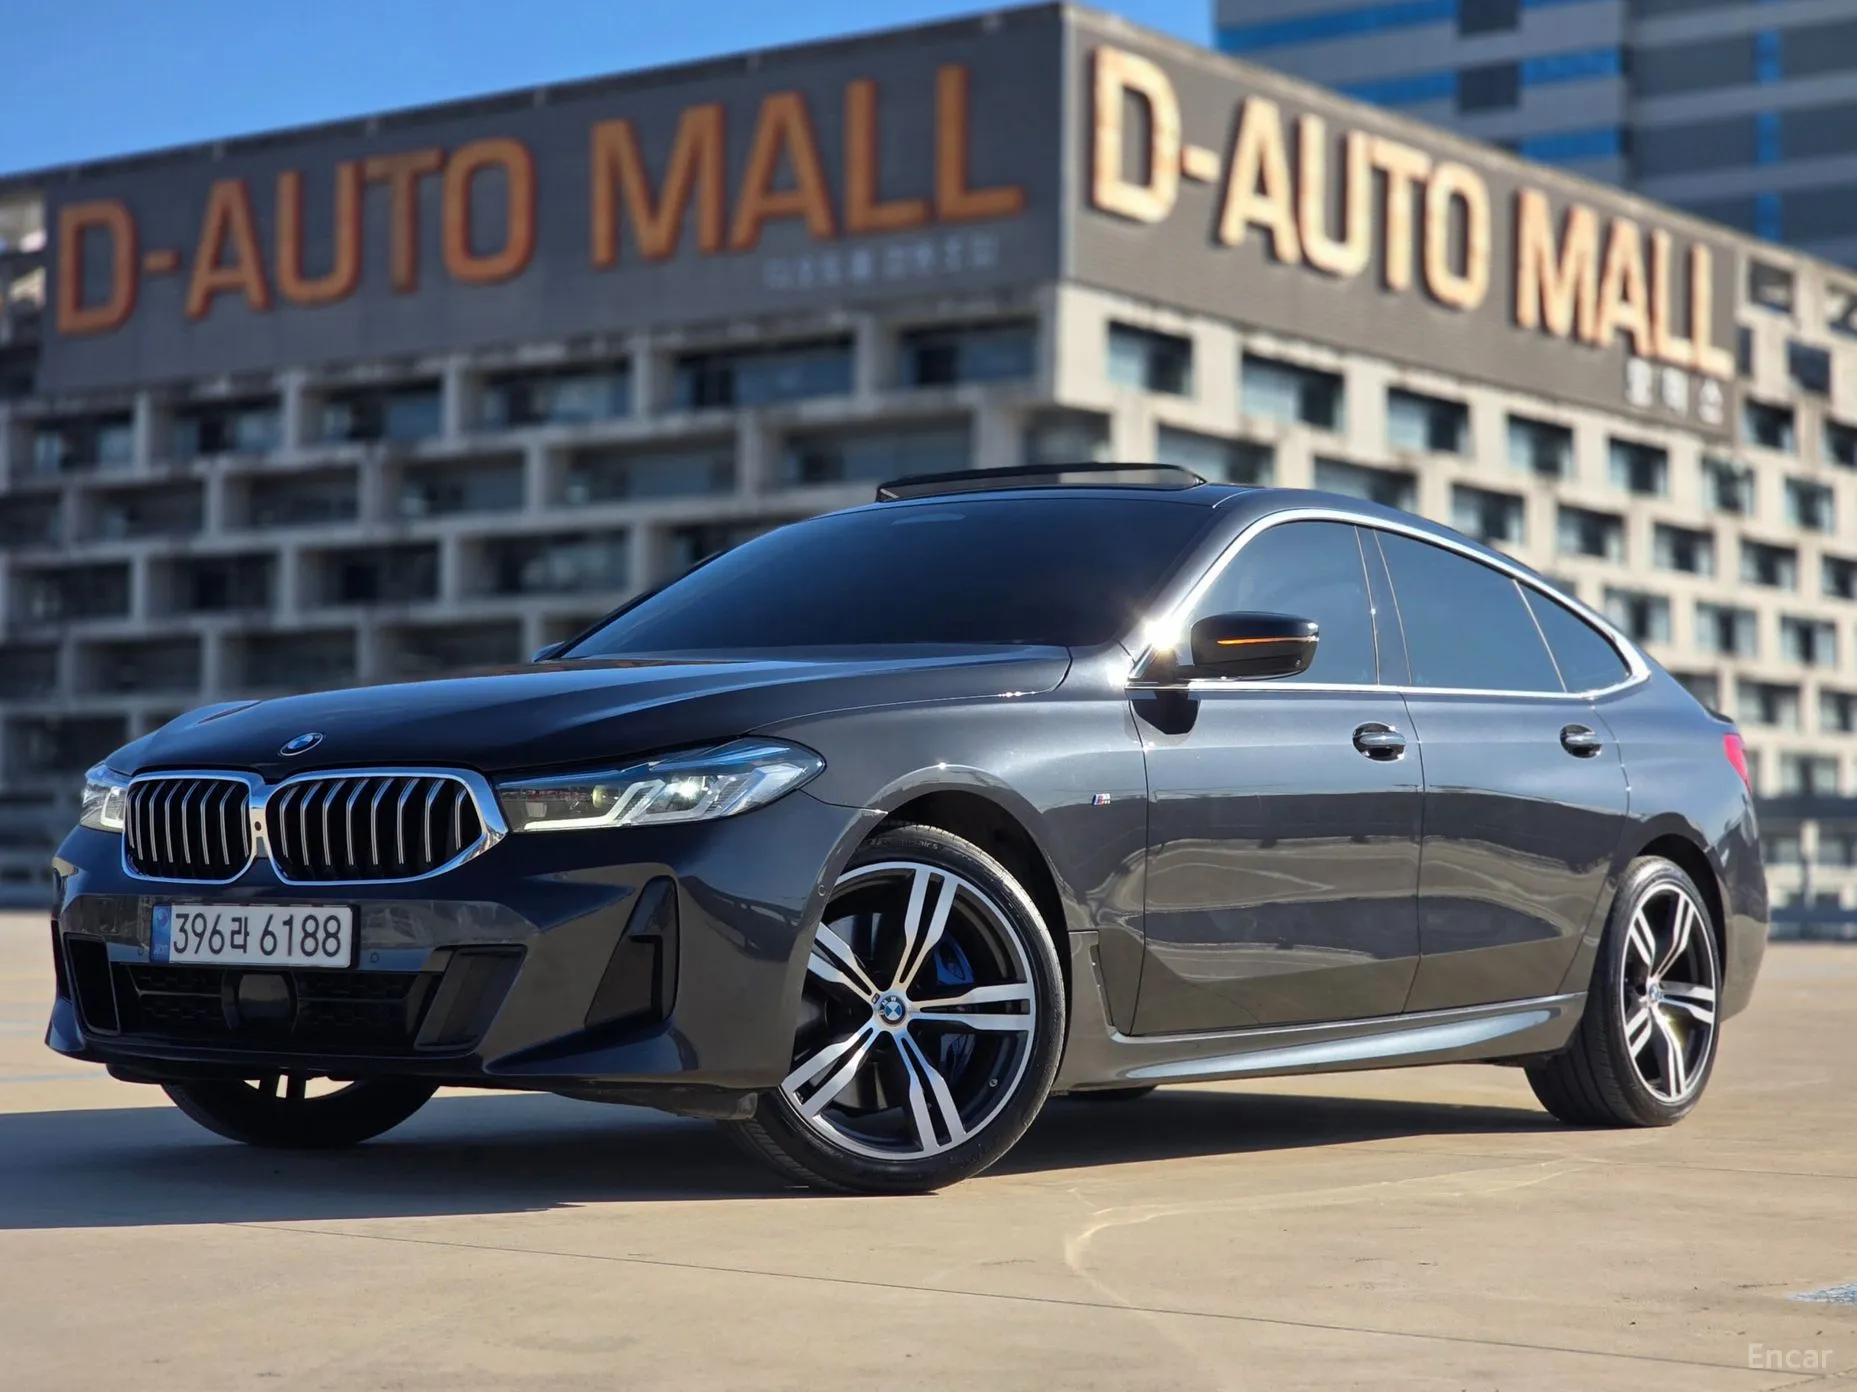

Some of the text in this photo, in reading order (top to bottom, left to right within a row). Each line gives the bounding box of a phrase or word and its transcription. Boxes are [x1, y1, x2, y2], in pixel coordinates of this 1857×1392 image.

[56, 63, 1027, 334] D-AUTO MALL
[1093, 44, 1735, 378] D-AUTO MALL
[173, 912, 342, 958] 396라 6188
